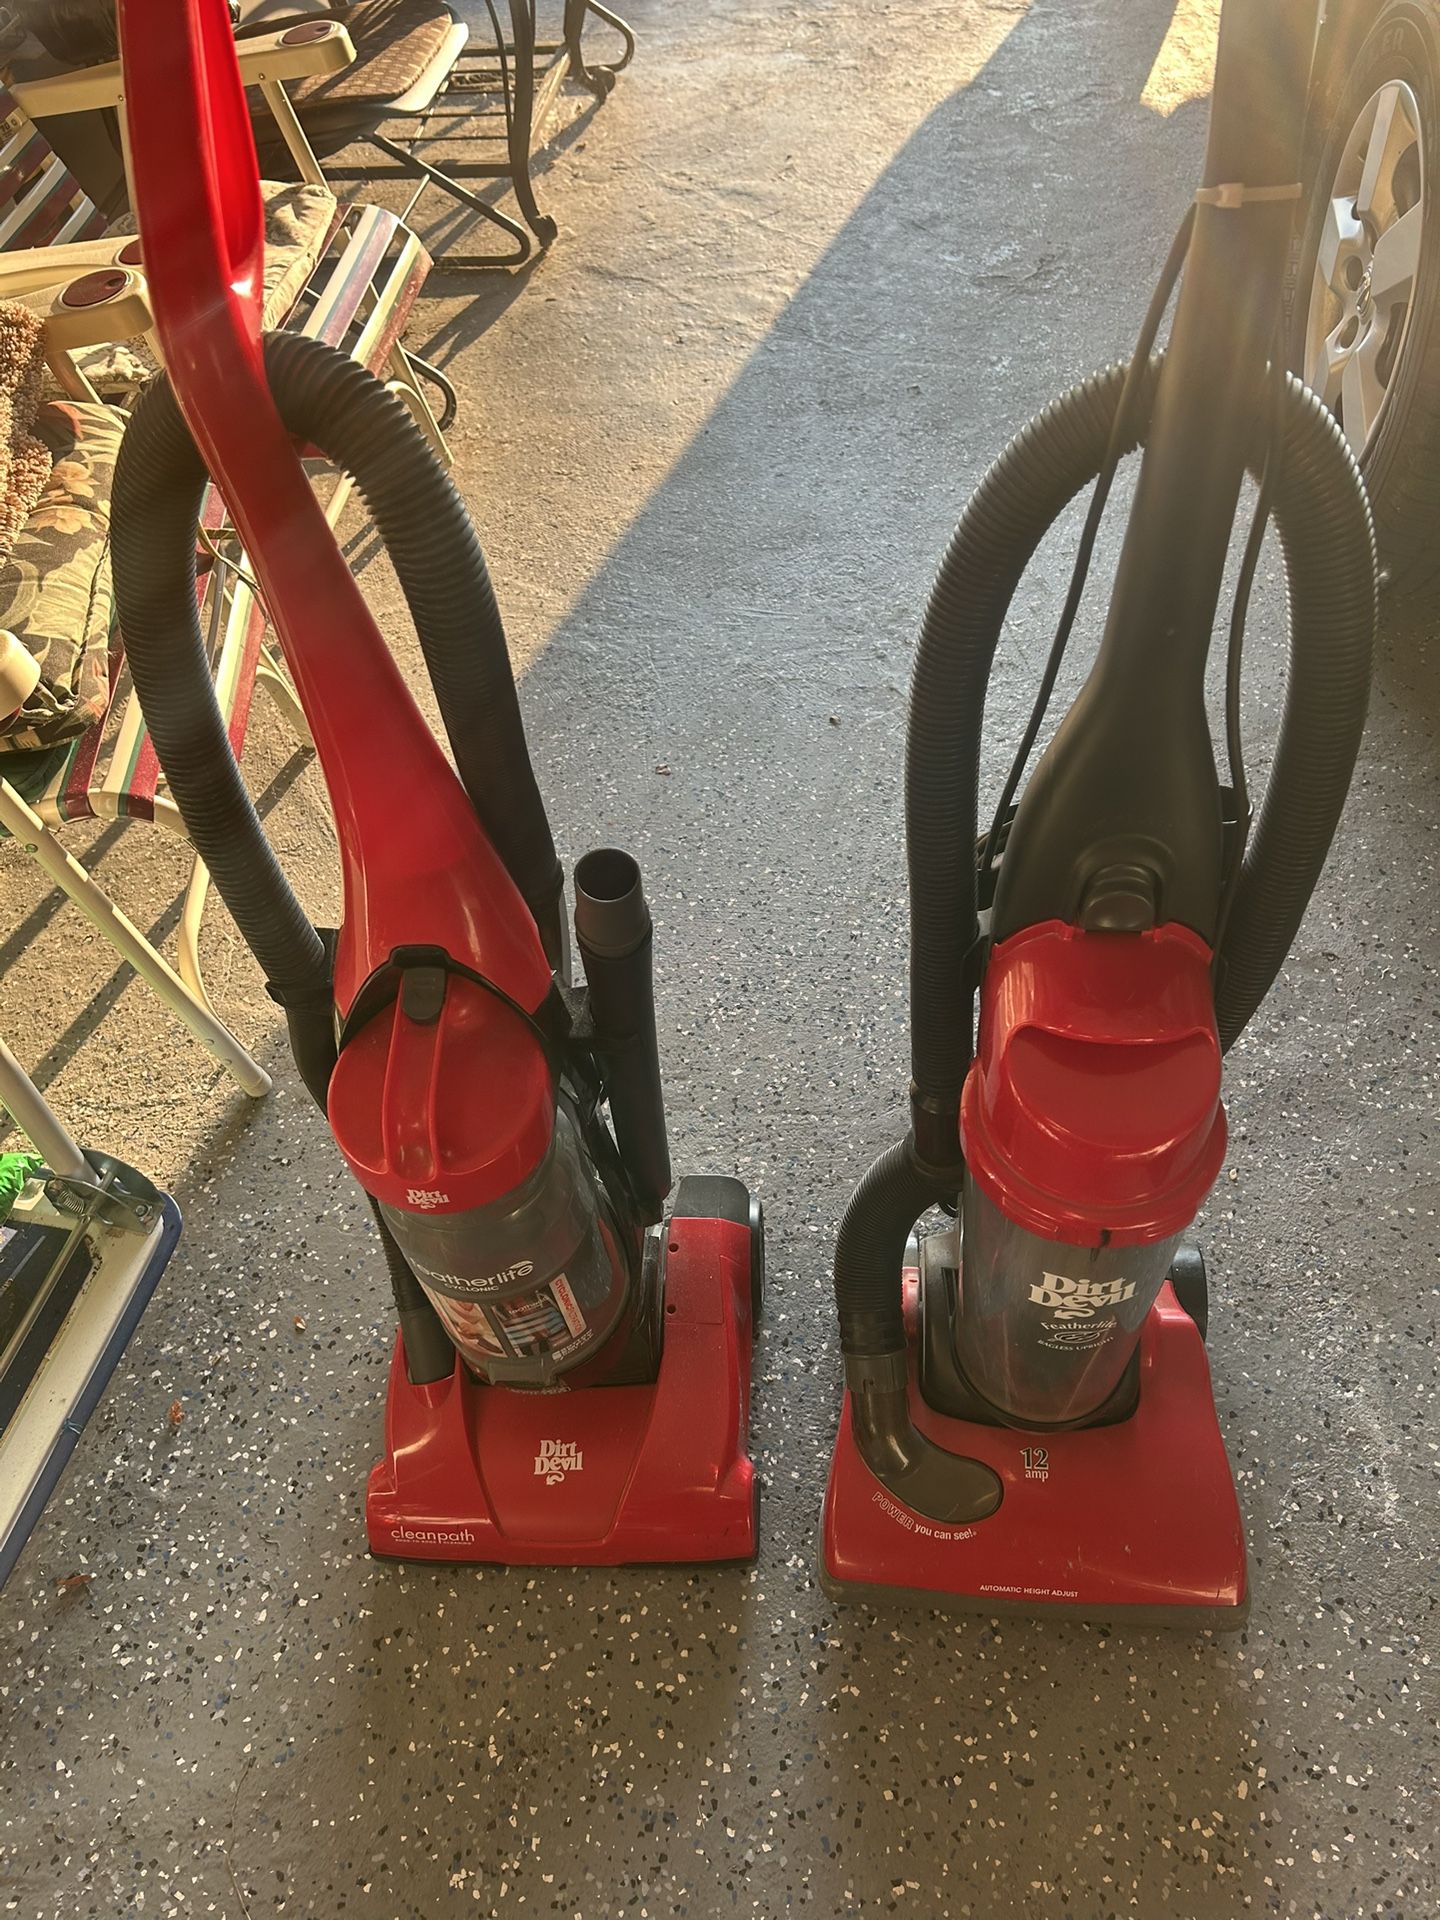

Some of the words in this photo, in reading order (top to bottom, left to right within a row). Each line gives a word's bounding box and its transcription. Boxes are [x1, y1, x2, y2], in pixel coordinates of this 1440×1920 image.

[406, 1189, 441, 1200] Dirt
[444, 1283, 500, 1292] CYCLONIC
[1042, 1271, 1126, 1296] Dirt
[1028, 1281, 1139, 1308] Devil
[540, 1439, 577, 1457] Dirt
[534, 1451, 583, 1475] Devil
[1020, 1447, 1049, 1470] 12
[1025, 1470, 1049, 1483] amp
[872, 1491, 915, 1531] POWER
[914, 1523, 932, 1537] you
[934, 1530, 952, 1540] can
[391, 1525, 475, 1544] cleanpath
[980, 1584, 1022, 1593] AUTOMATIC
[1023, 1587, 1050, 1595] HEIGHT
[1051, 1589, 1079, 1598] ADJUST
